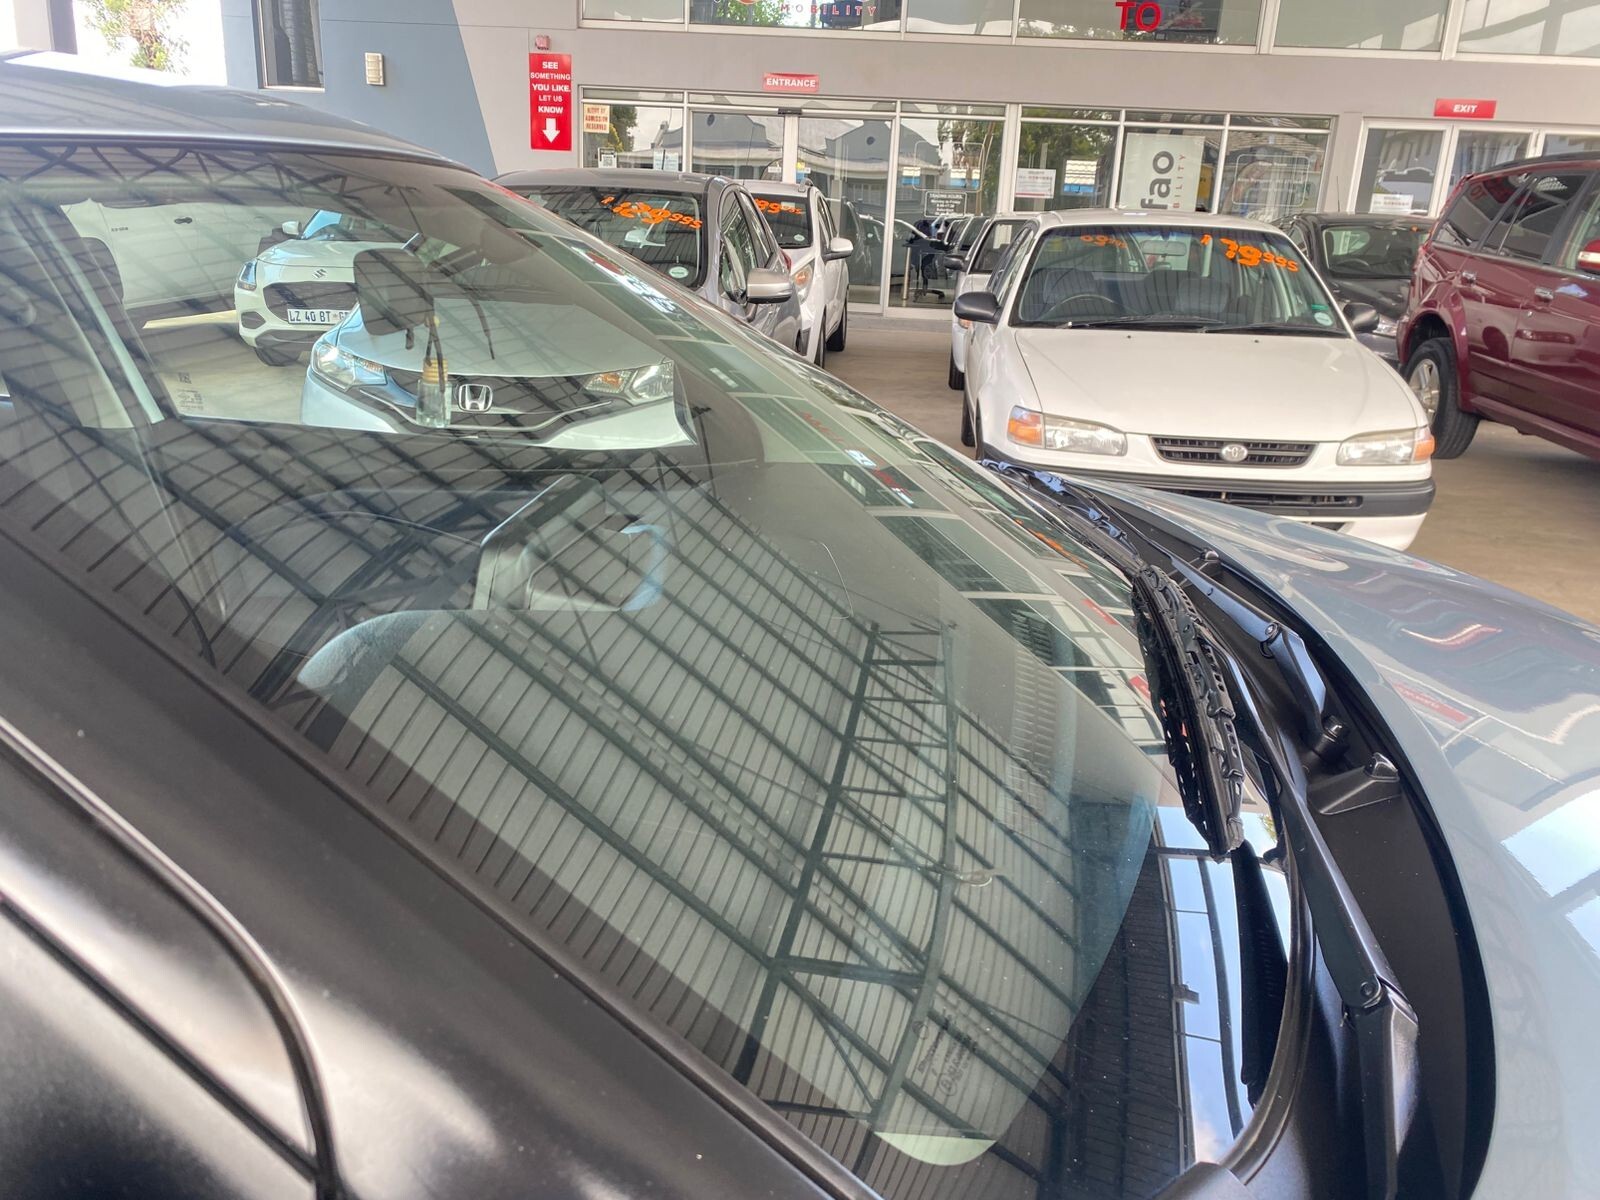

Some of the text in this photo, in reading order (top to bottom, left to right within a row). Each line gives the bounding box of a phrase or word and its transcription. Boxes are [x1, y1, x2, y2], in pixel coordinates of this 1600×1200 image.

[780, 4, 877, 17] MOBILITY
[1115, 1, 1162, 32] TO
[542, 61, 559, 70] SEE
[530, 72, 571, 80] SOMETHING
[766, 77, 816, 88] ENTRANCE
[538, 106, 563, 114] KNOW
[1453, 104, 1478, 114] EXIT
[289, 310, 301, 322] LZ
[305, 311, 316, 322] 40
[319, 311, 331, 322] BT
